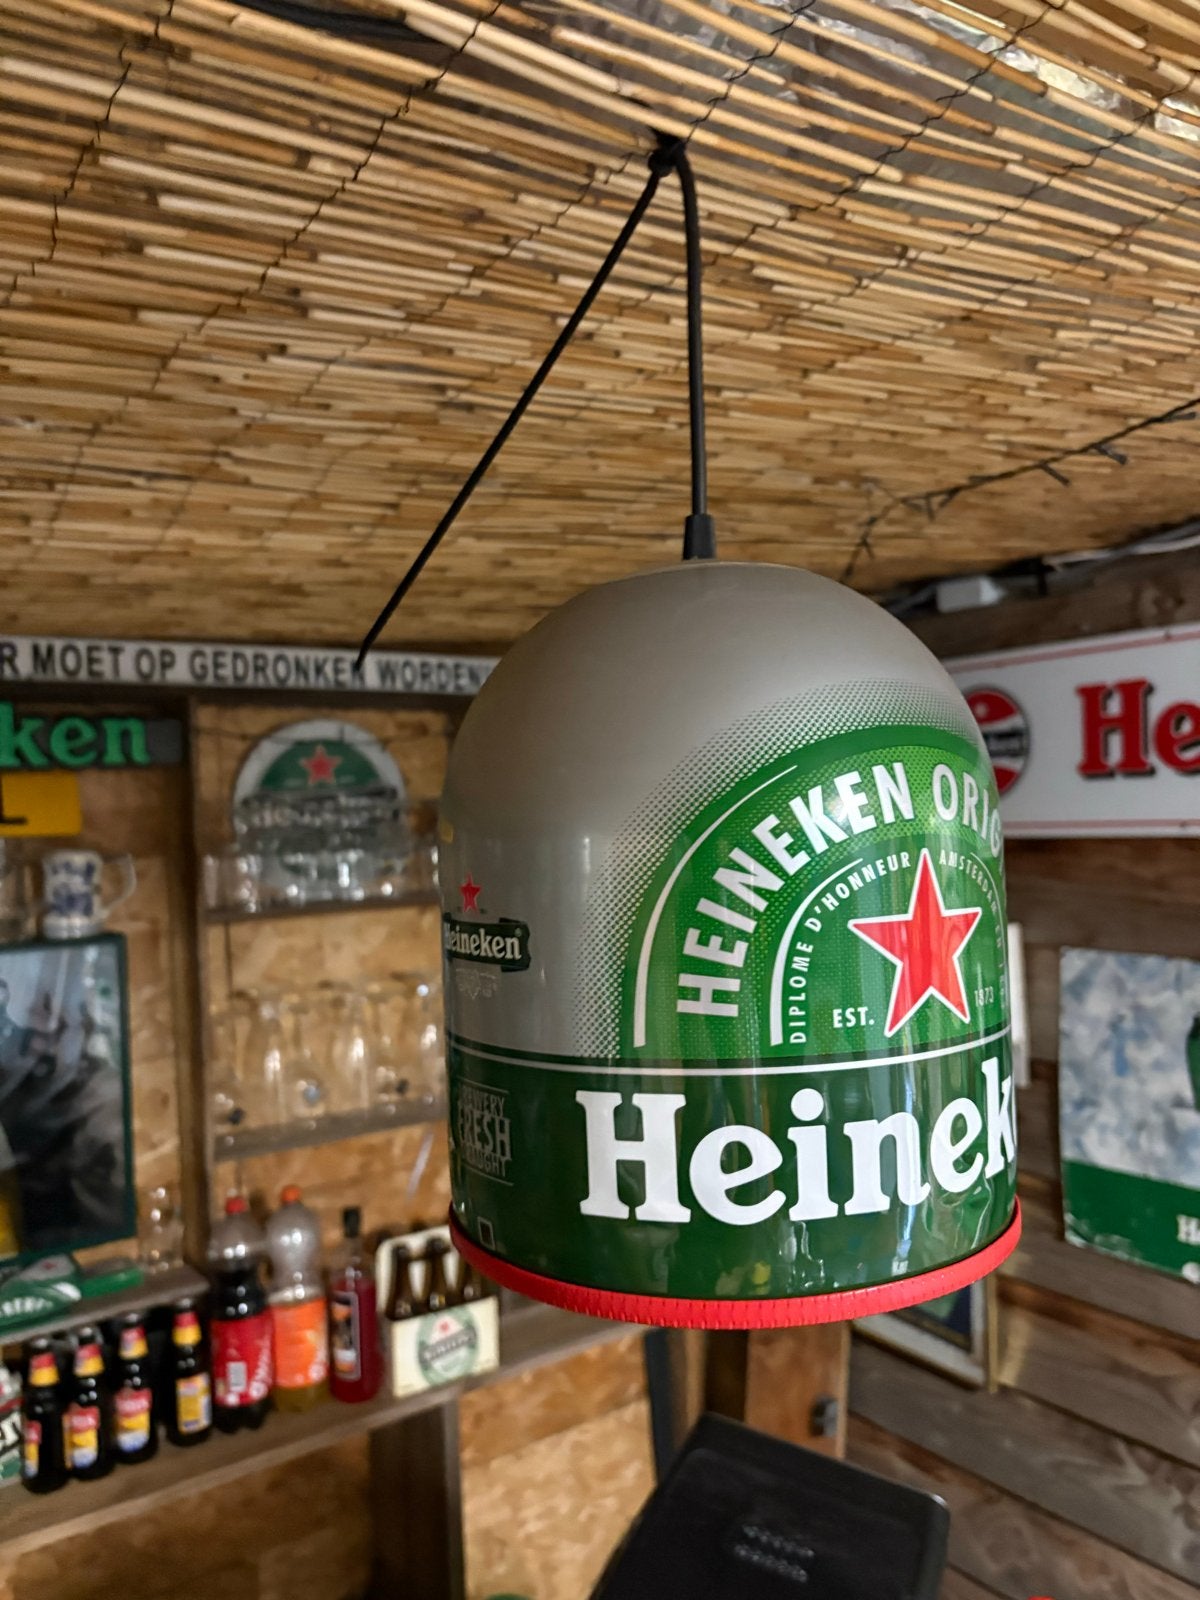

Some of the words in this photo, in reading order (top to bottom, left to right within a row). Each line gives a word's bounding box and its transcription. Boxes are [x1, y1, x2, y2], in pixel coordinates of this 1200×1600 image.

[31, 642, 125, 679] MOET
[134, 646, 177, 682] OP
[0, 702, 150, 768] ken
[676, 761, 915, 1017] HEINEKEN
[788, 941, 814, 1043] DIPLOME
[804, 851, 911, 932] D'HONNEUR
[938, 848, 998, 916] AMSTERDAM
[832, 1006, 875, 1029] EST.
[973, 985, 995, 1007] 1873
[575, 1056, 1018, 1226] Heinek
